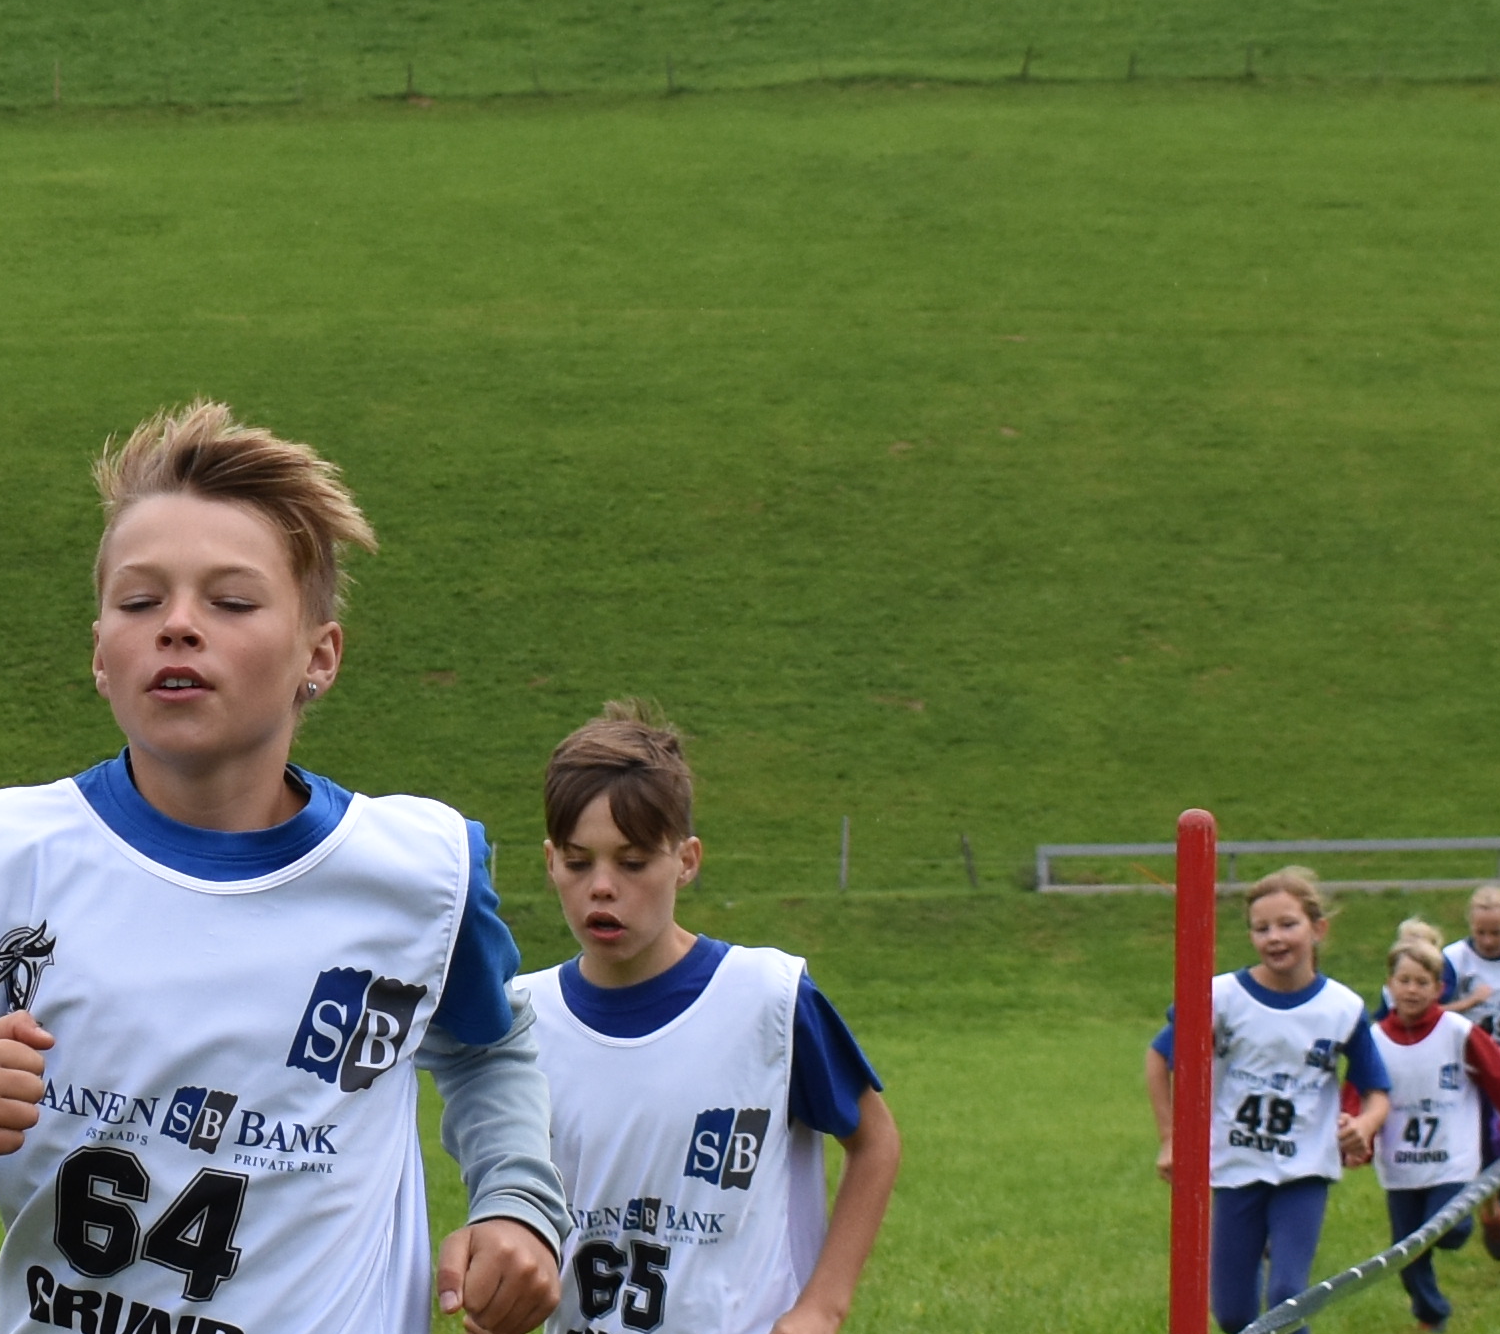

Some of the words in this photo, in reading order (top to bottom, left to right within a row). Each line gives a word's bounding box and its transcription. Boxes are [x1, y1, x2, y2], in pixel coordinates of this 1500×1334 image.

[304, 1000, 400, 1070] SB
[38, 1070, 161, 1127] AANEN
[168, 1102, 223, 1140] SB
[234, 1109, 338, 1154] BANK
[1235, 1094, 1296, 1135] 48
[1403, 1117, 1440, 1148] 47
[233, 1153, 294, 1172] PRIVATE
[300, 1161, 335, 1174] BANK
[692, 1130, 758, 1173] SB
[53, 1145, 250, 1303] 64
[665, 1205, 726, 1234] BANK
[572, 1239, 671, 1334] 65
